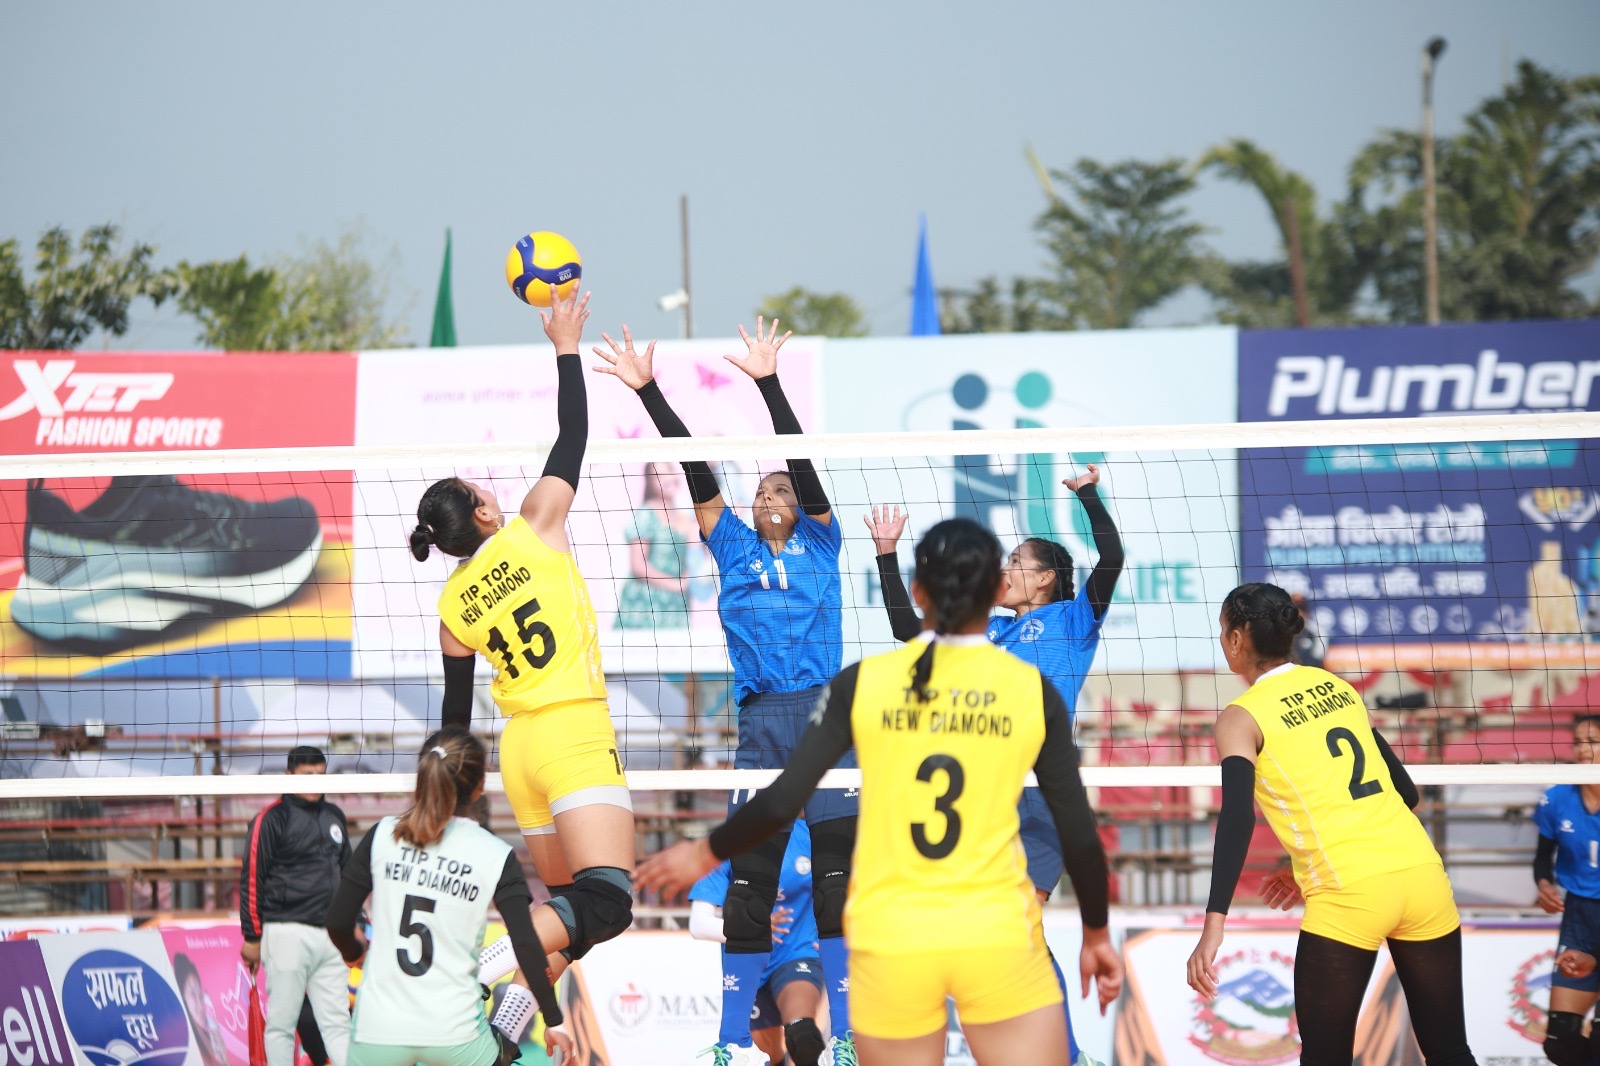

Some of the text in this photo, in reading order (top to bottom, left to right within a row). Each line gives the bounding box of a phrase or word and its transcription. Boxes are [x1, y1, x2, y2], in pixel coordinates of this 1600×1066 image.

[0, 360, 174, 418] XTEP
[1268, 351, 1600, 416] Plumber
[35, 417, 223, 447] FASHION SPORTS
[460, 561, 510, 606] TIP TOP
[760, 559, 789, 590] 11
[460, 566, 532, 628] NEW DIAMOND
[486, 597, 557, 680] 15
[902, 687, 997, 708] TP TOP
[1280, 681, 1335, 708] TIP TOP
[1280, 691, 1356, 729] NEW DIAMOND
[882, 708, 1013, 738] NEW DIAMOND
[609, 749, 624, 776] 1
[1326, 727, 1384, 801] 2
[910, 753, 965, 861] 3
[385, 862, 479, 902] NEW DIAMOND
[401, 847, 472, 877] TIP TOP
[396, 894, 437, 977] 5
[83, 967, 148, 1010] सफल
[0, 985, 63, 1066] ell
[121, 1013, 160, 1050] दूध
